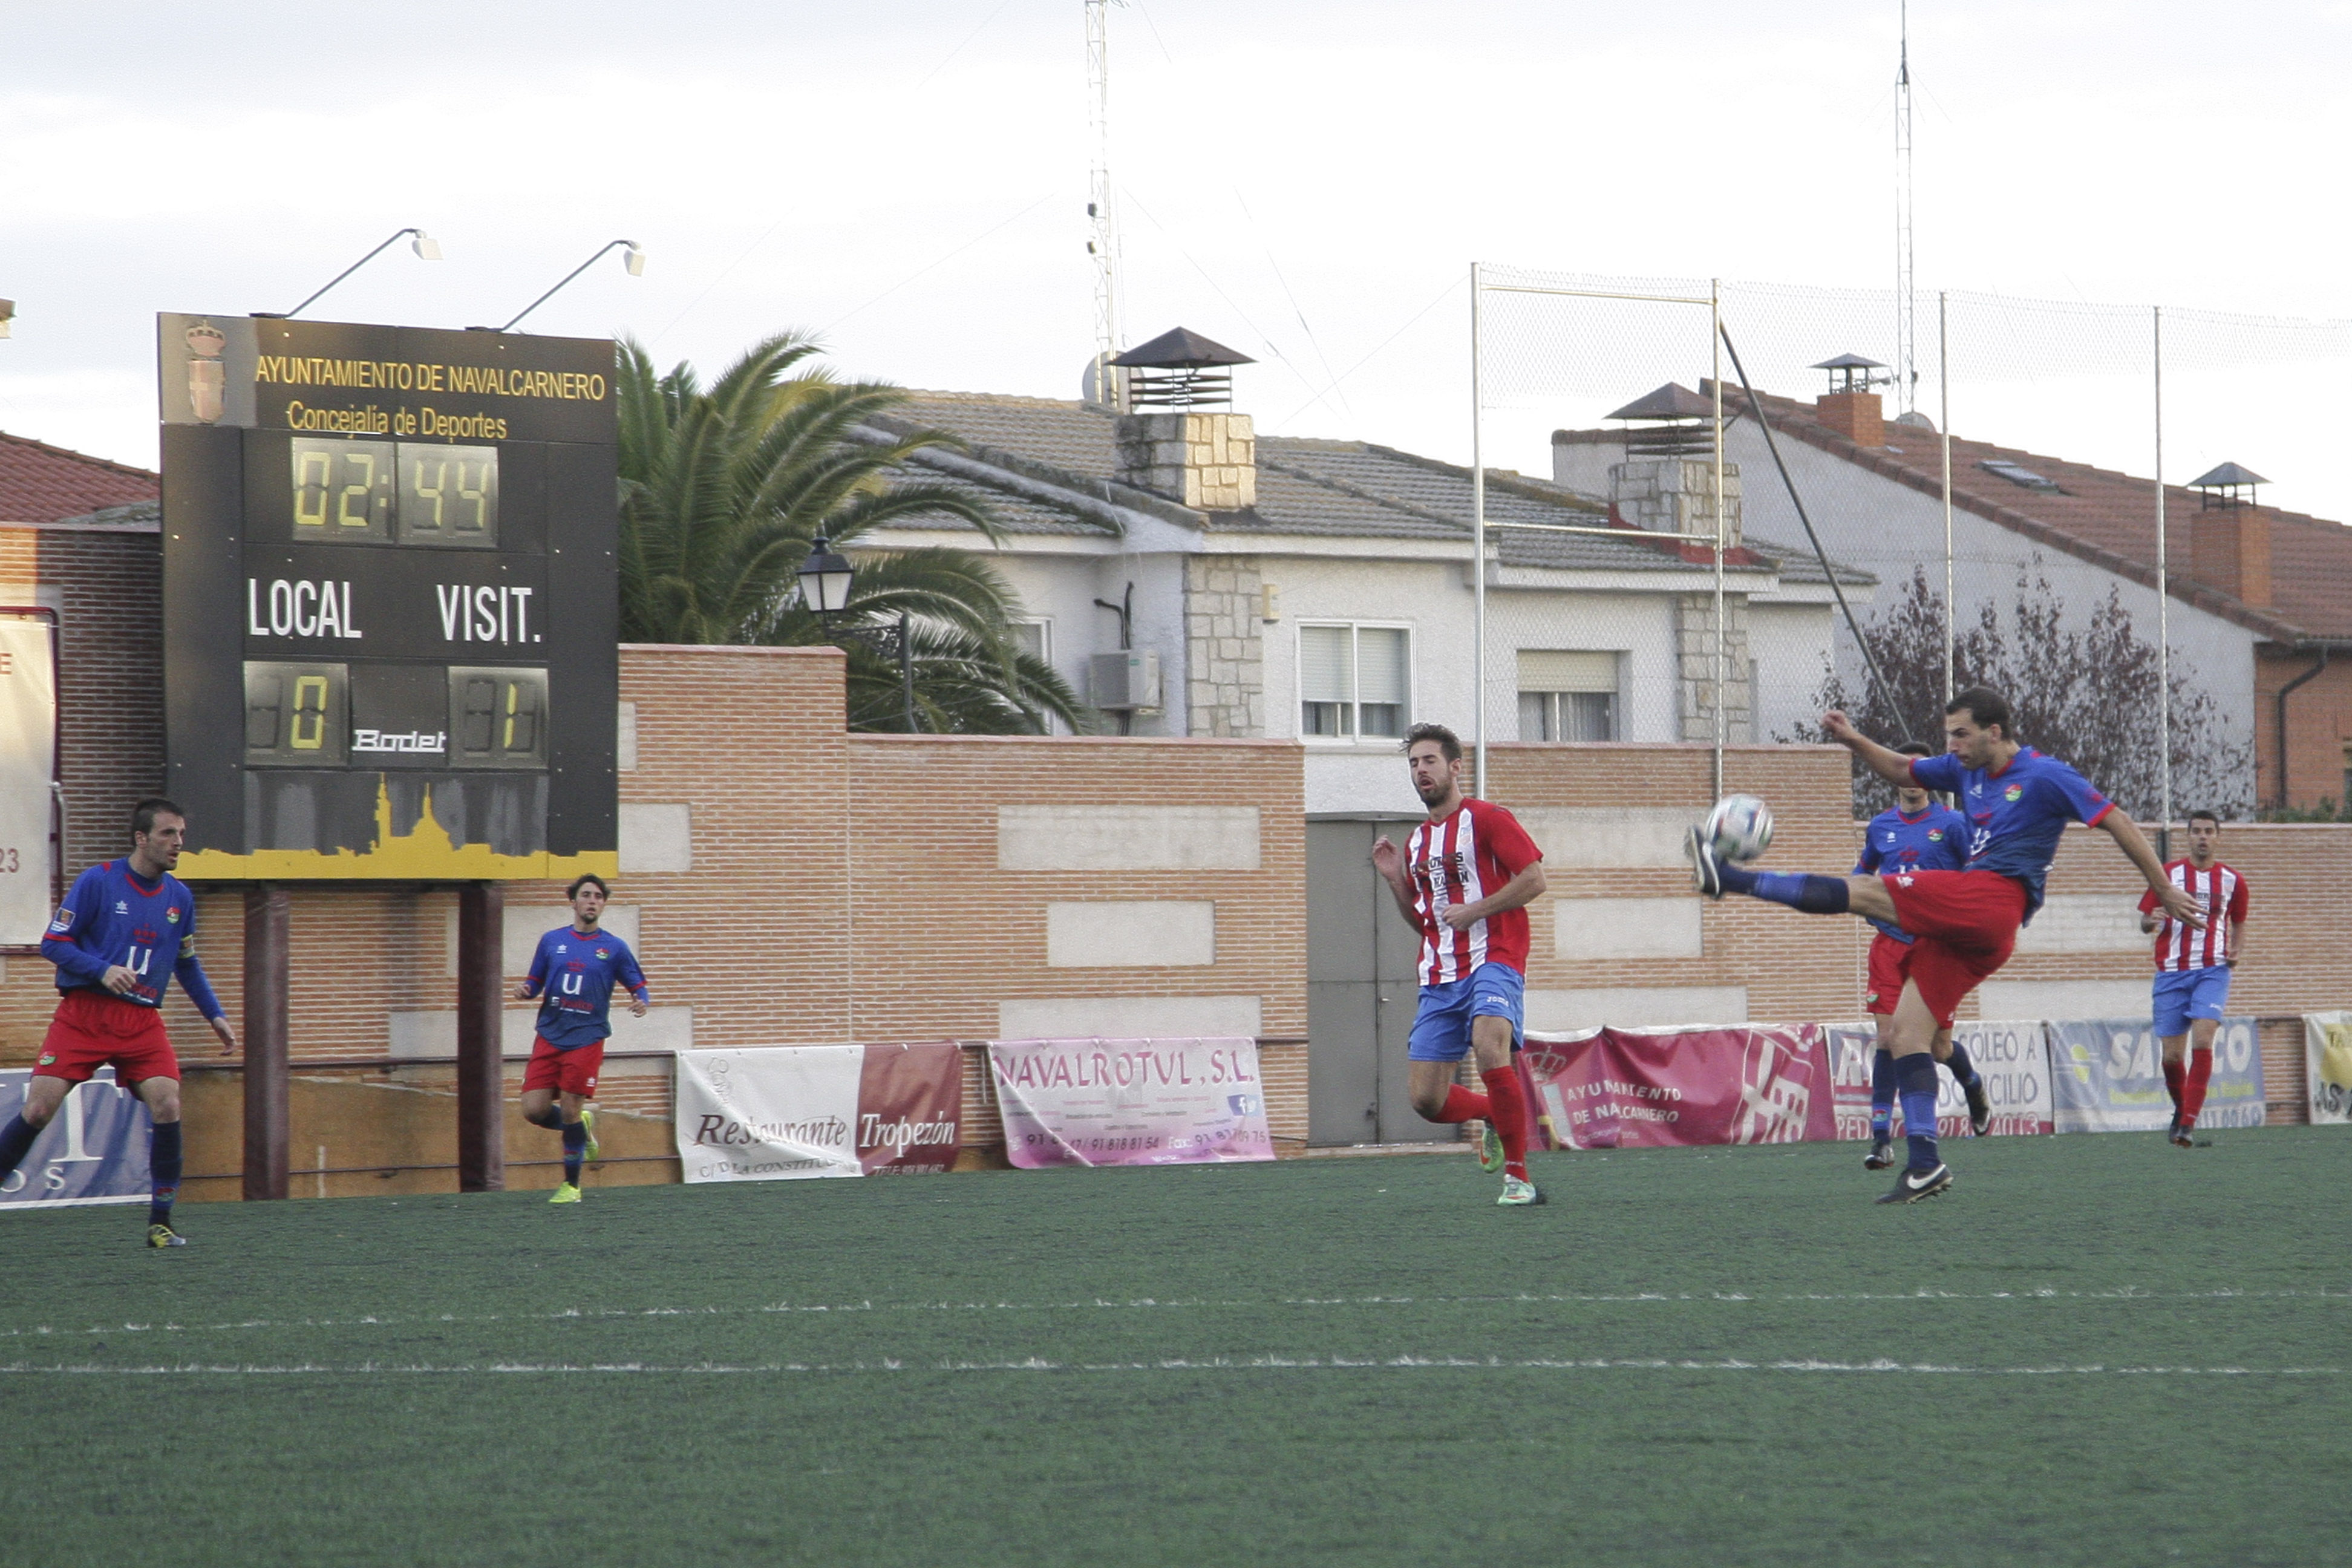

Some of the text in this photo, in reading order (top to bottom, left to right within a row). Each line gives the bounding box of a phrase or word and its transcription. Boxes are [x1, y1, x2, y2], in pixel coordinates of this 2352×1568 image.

[255, 355, 605, 401] AYUNTAMIENTO DE NAVALCARNERO
[288, 400, 508, 443] Concejalía de Deportes
[294, 451, 488, 528] 02:44
[249, 578, 362, 638] LOCAL
[436, 584, 541, 643] VISIT.
[290, 676, 328, 750] 0
[503, 683, 517, 748] 1
[351, 730, 447, 753] Bodet
[1567, 1079, 1682, 1102] AYUNAMIENTO
[859, 1111, 955, 1158] Tropezón
